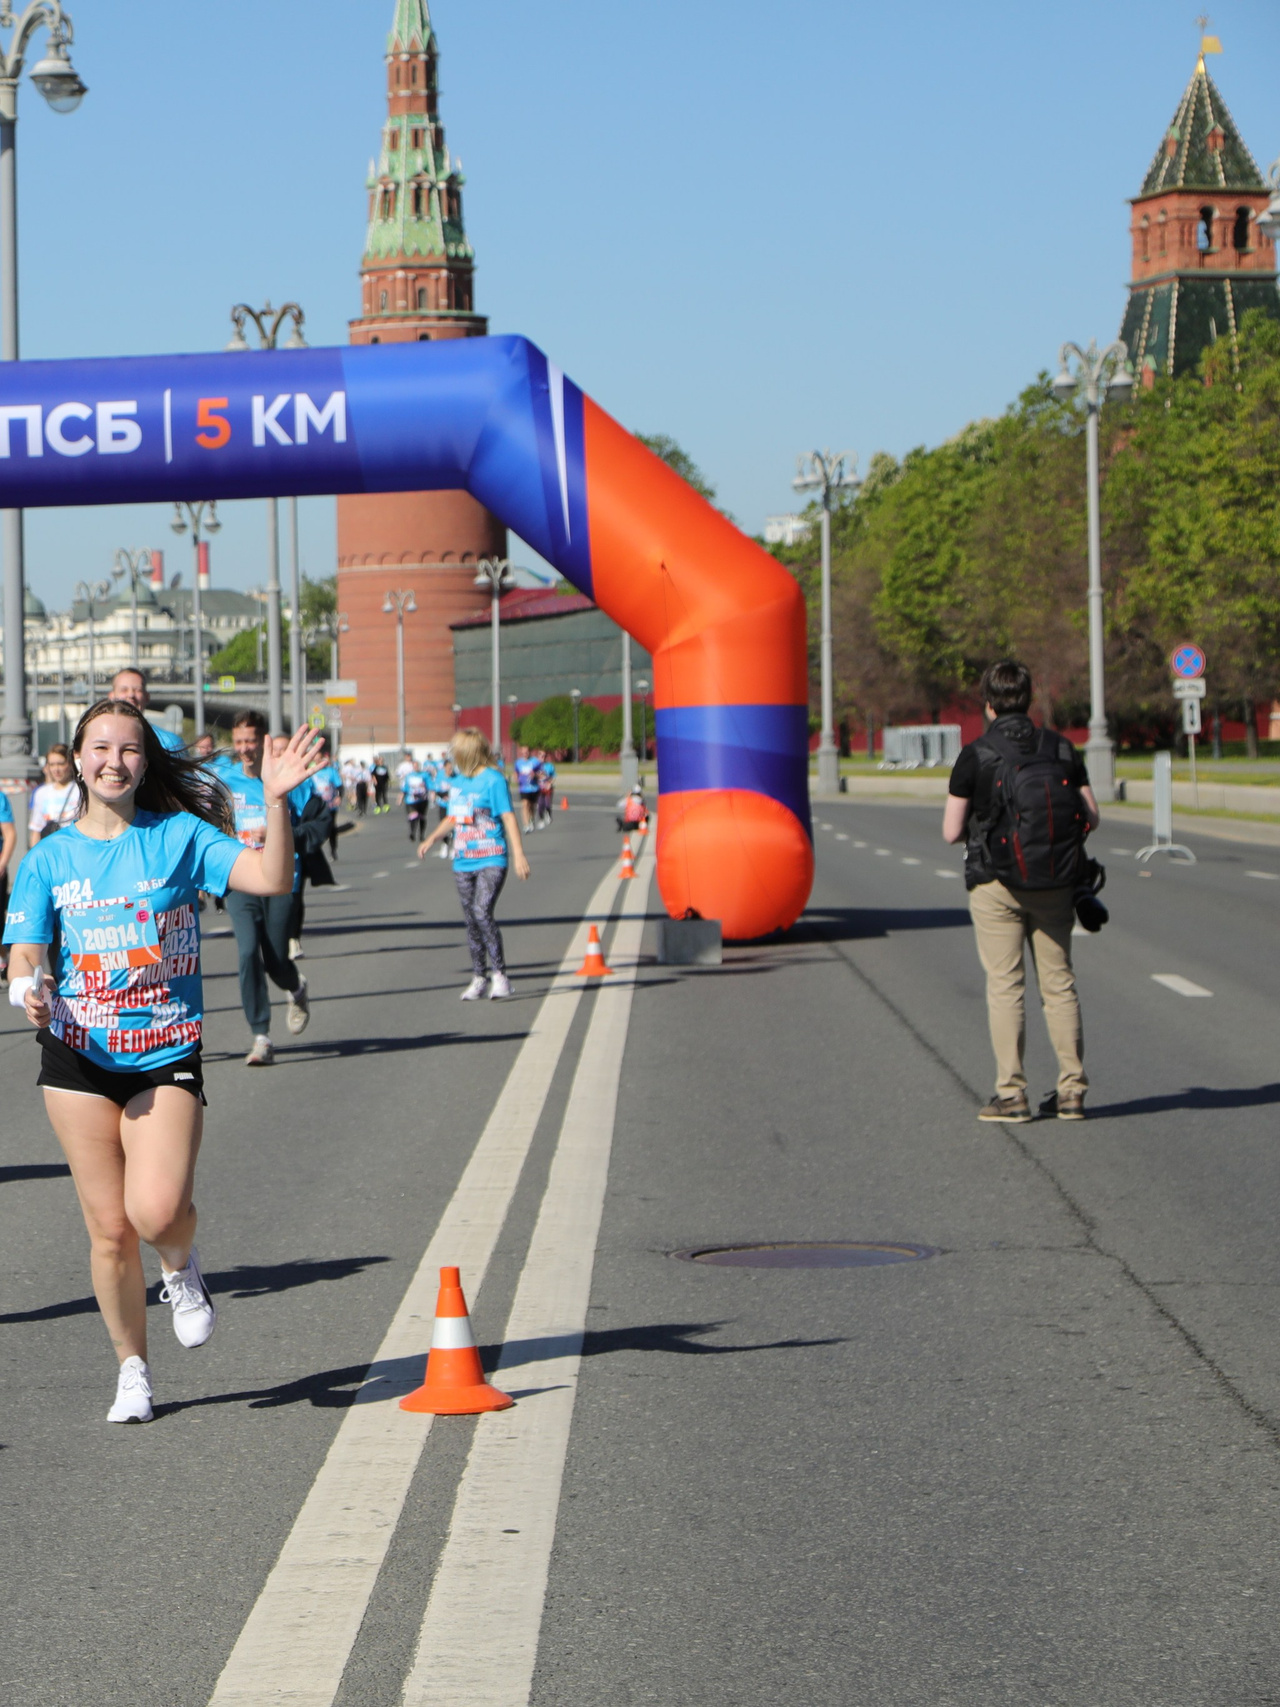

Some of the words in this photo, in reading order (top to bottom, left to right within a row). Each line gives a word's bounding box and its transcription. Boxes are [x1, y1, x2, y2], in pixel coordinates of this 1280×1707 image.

[195, 397, 231, 449] 5
[252, 391, 346, 447] КМ
[53, 878, 93, 909] 2024
[82, 922, 139, 951] 20914
[108, 1020, 202, 1053] #ЕДИНСТВО
